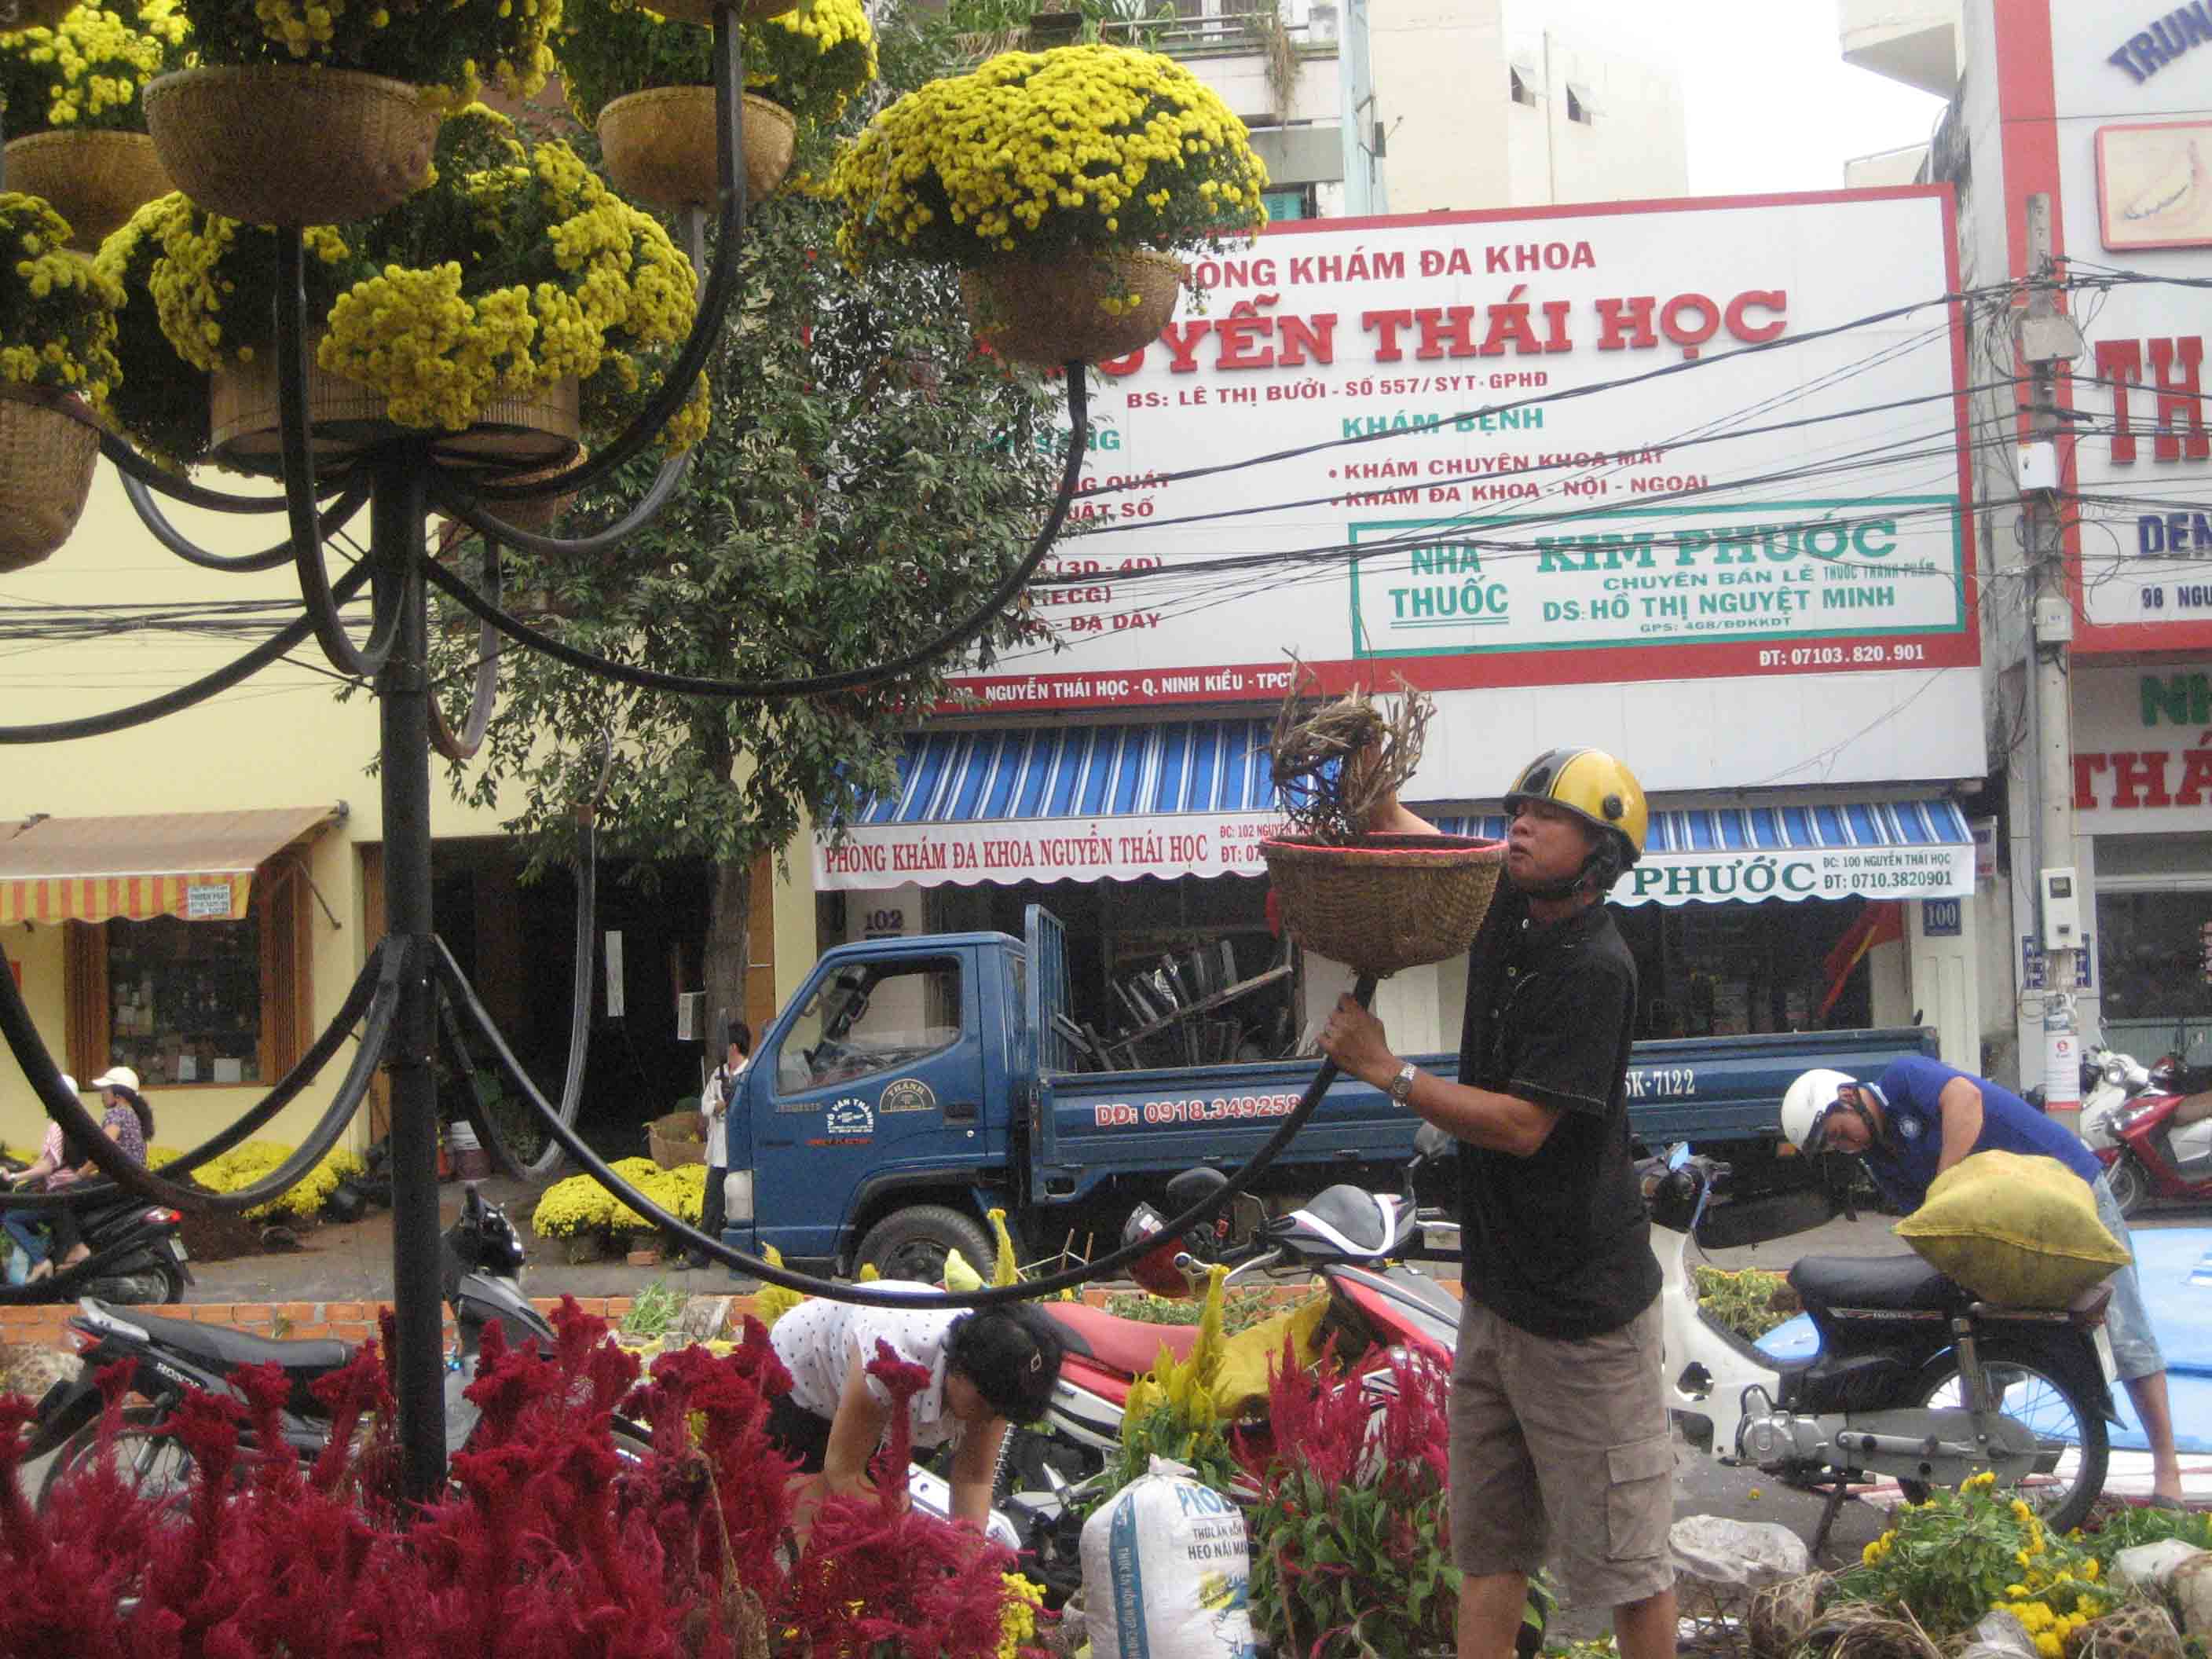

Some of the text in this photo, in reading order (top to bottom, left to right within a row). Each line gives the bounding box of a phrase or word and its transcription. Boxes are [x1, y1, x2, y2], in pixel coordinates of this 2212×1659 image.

[2107, 2, 2212, 85] TRUN
[1290, 246, 1406, 285] KHÁM
[1419, 247, 1471, 278] ĐA
[1486, 240, 1596, 274] KHOA
[1362, 284, 1572, 362] THÁI
[1595, 289, 1787, 360] HỌC
[1127, 392, 1170, 409] BS:
[1178, 385, 1207, 407] LÊ
[1218, 386, 1258, 408] THỊ
[1345, 376, 1373, 397] SỐ
[1342, 405, 1544, 439] KHÁM BỆNH
[1344, 454, 1418, 480] KHÁM
[1428, 451, 1529, 476] CHUYÊN
[1539, 451, 1610, 470] KHOA
[1346, 485, 1419, 507] KHÁM
[1428, 484, 1461, 504] ĐA
[1472, 482, 1540, 501] KHOA
[1562, 476, 1607, 499] NỘI
[1535, 513, 1898, 573] KIM PHƯỚC
[1602, 571, 1708, 591] CHUYÊN
[1719, 568, 1773, 587] BÁN
[1388, 575, 1510, 618] THUỐC
[1640, 595, 1688, 621] THỊ
[1699, 588, 1811, 615] NGUYỆT
[1822, 586, 1895, 610] MINH
[985, 673, 1049, 701] NGUYỄN
[1053, 677, 1092, 699] THÁI
[1097, 679, 1130, 701] HỌC
[1162, 676, 1199, 694] NINH
[1205, 668, 1243, 692] KIỀU
[1238, 823, 1254, 838] 102
[892, 835, 947, 871] KHÁM
[952, 841, 979, 869] ĐA
[983, 839, 1035, 868] KHOA
[1118, 829, 1164, 865] THÁI
[1170, 834, 1208, 869] HỌC
[1843, 856, 1861, 868] 100
[1632, 855, 1817, 896] PHƯỚC
[1851, 871, 1954, 888] 0710.3820901
[1927, 903, 1957, 927] 100
[1188, 1544, 1212, 1559] HEO
